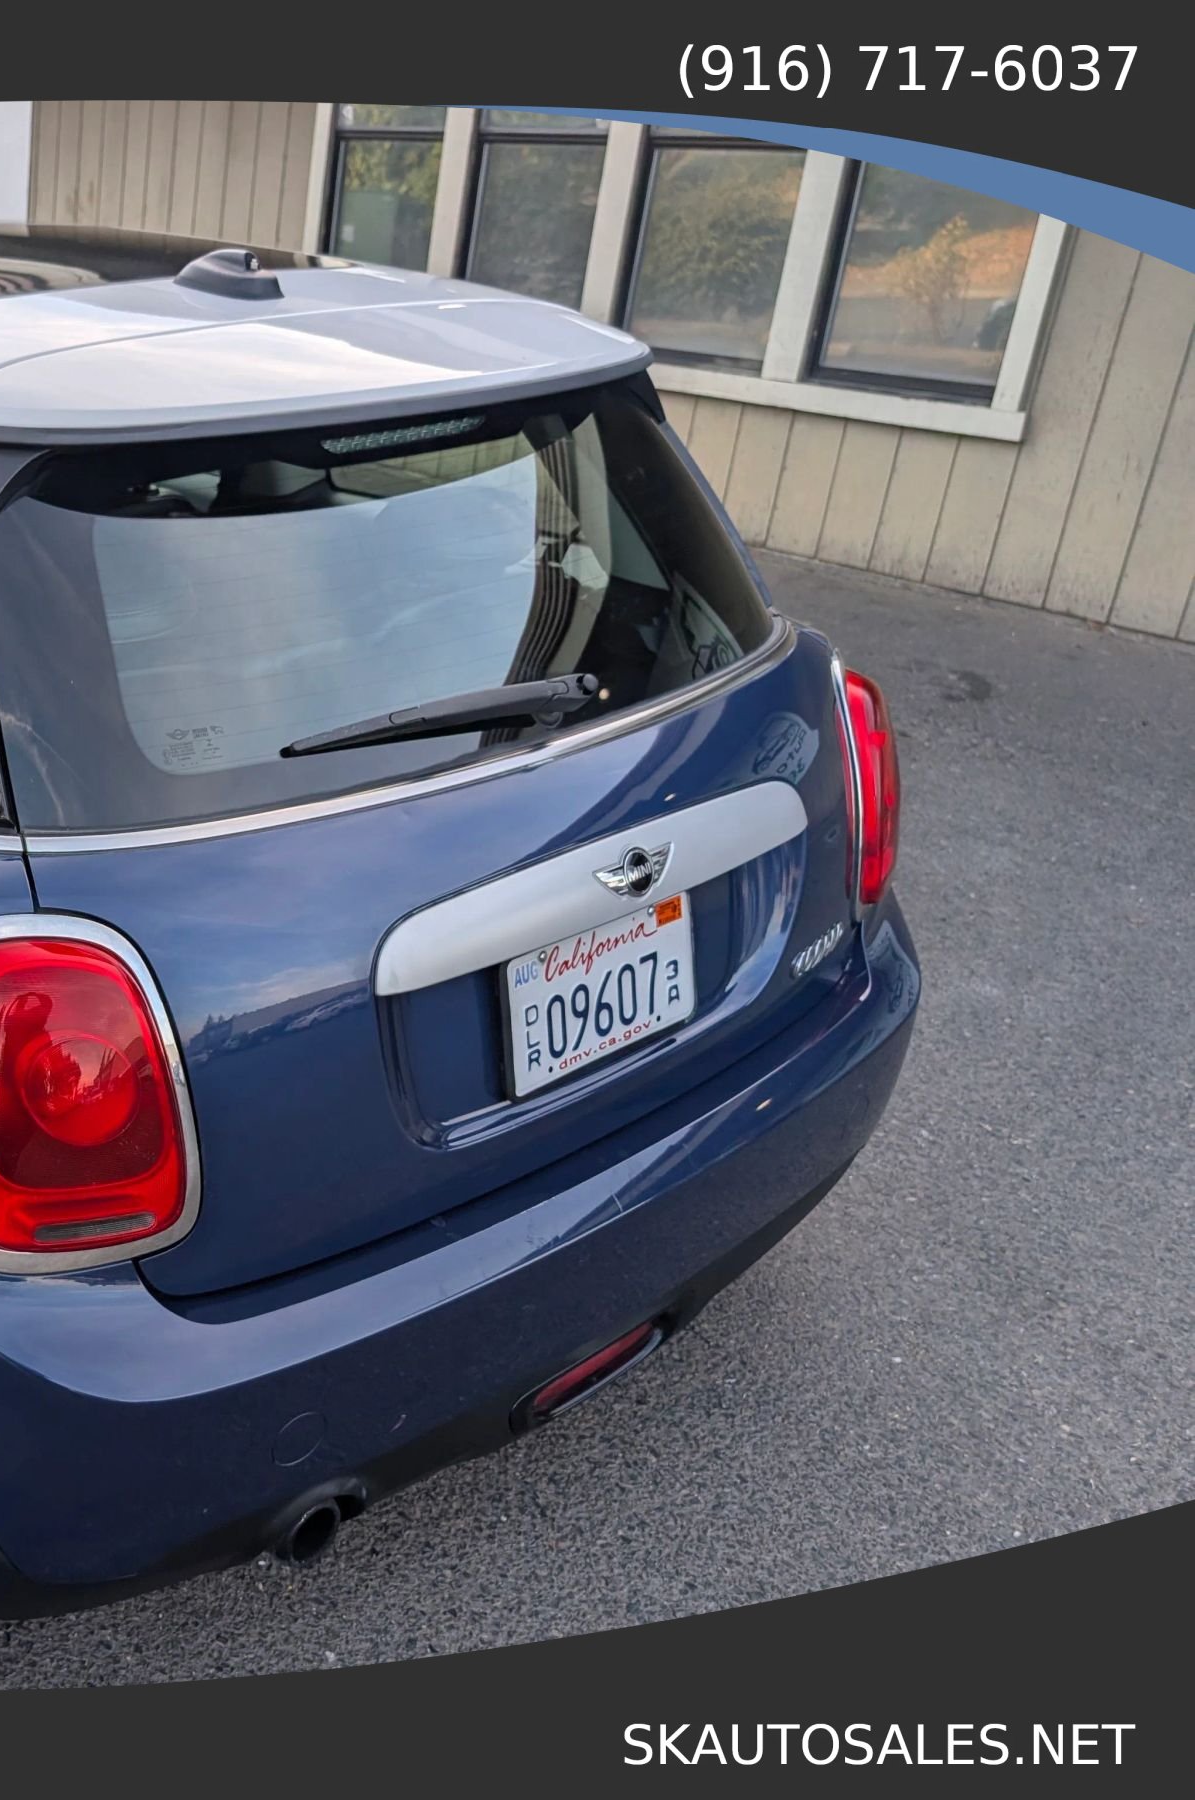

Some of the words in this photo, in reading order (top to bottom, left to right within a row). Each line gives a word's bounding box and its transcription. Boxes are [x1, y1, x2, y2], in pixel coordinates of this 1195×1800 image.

[627, 862, 652, 883] MINI
[514, 961, 540, 988] AUG
[544, 917, 658, 982] California
[546, 951, 658, 1059] 09607
[558, 1020, 652, 1070] dmv.ca.gov
